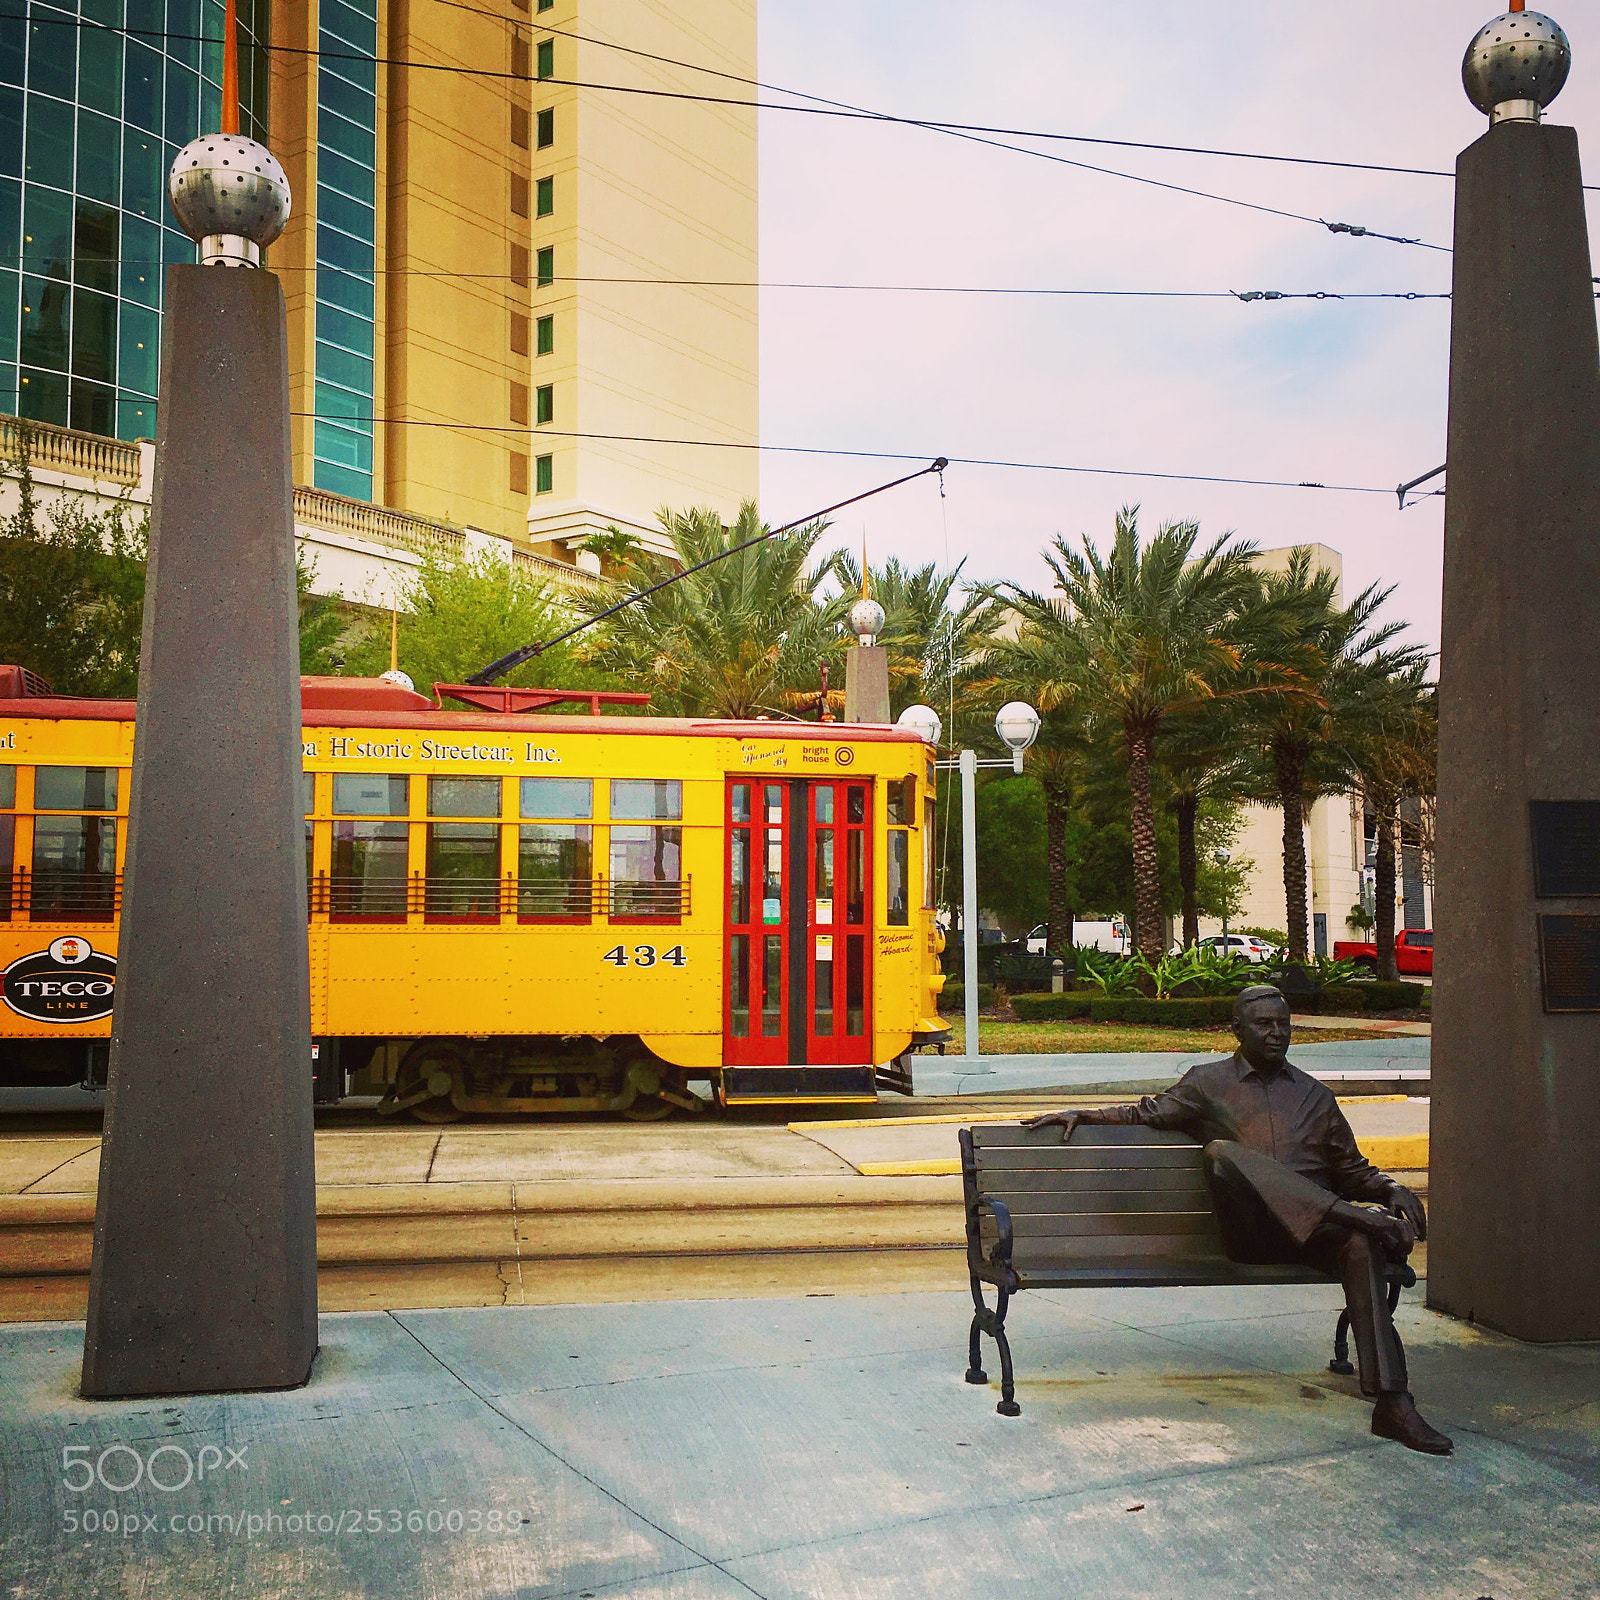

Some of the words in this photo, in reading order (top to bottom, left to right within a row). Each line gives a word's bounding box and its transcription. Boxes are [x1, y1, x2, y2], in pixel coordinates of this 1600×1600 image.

[420, 739, 514, 764] Streetcar,
[524, 742, 562, 763] Inc.
[802, 746, 829, 756] bright
[802, 755, 829, 763] house
[878, 933, 914, 944] Welcome
[603, 944, 688, 968] 434
[879, 944, 911, 957] Aboard
[14, 981, 114, 997] TECO
